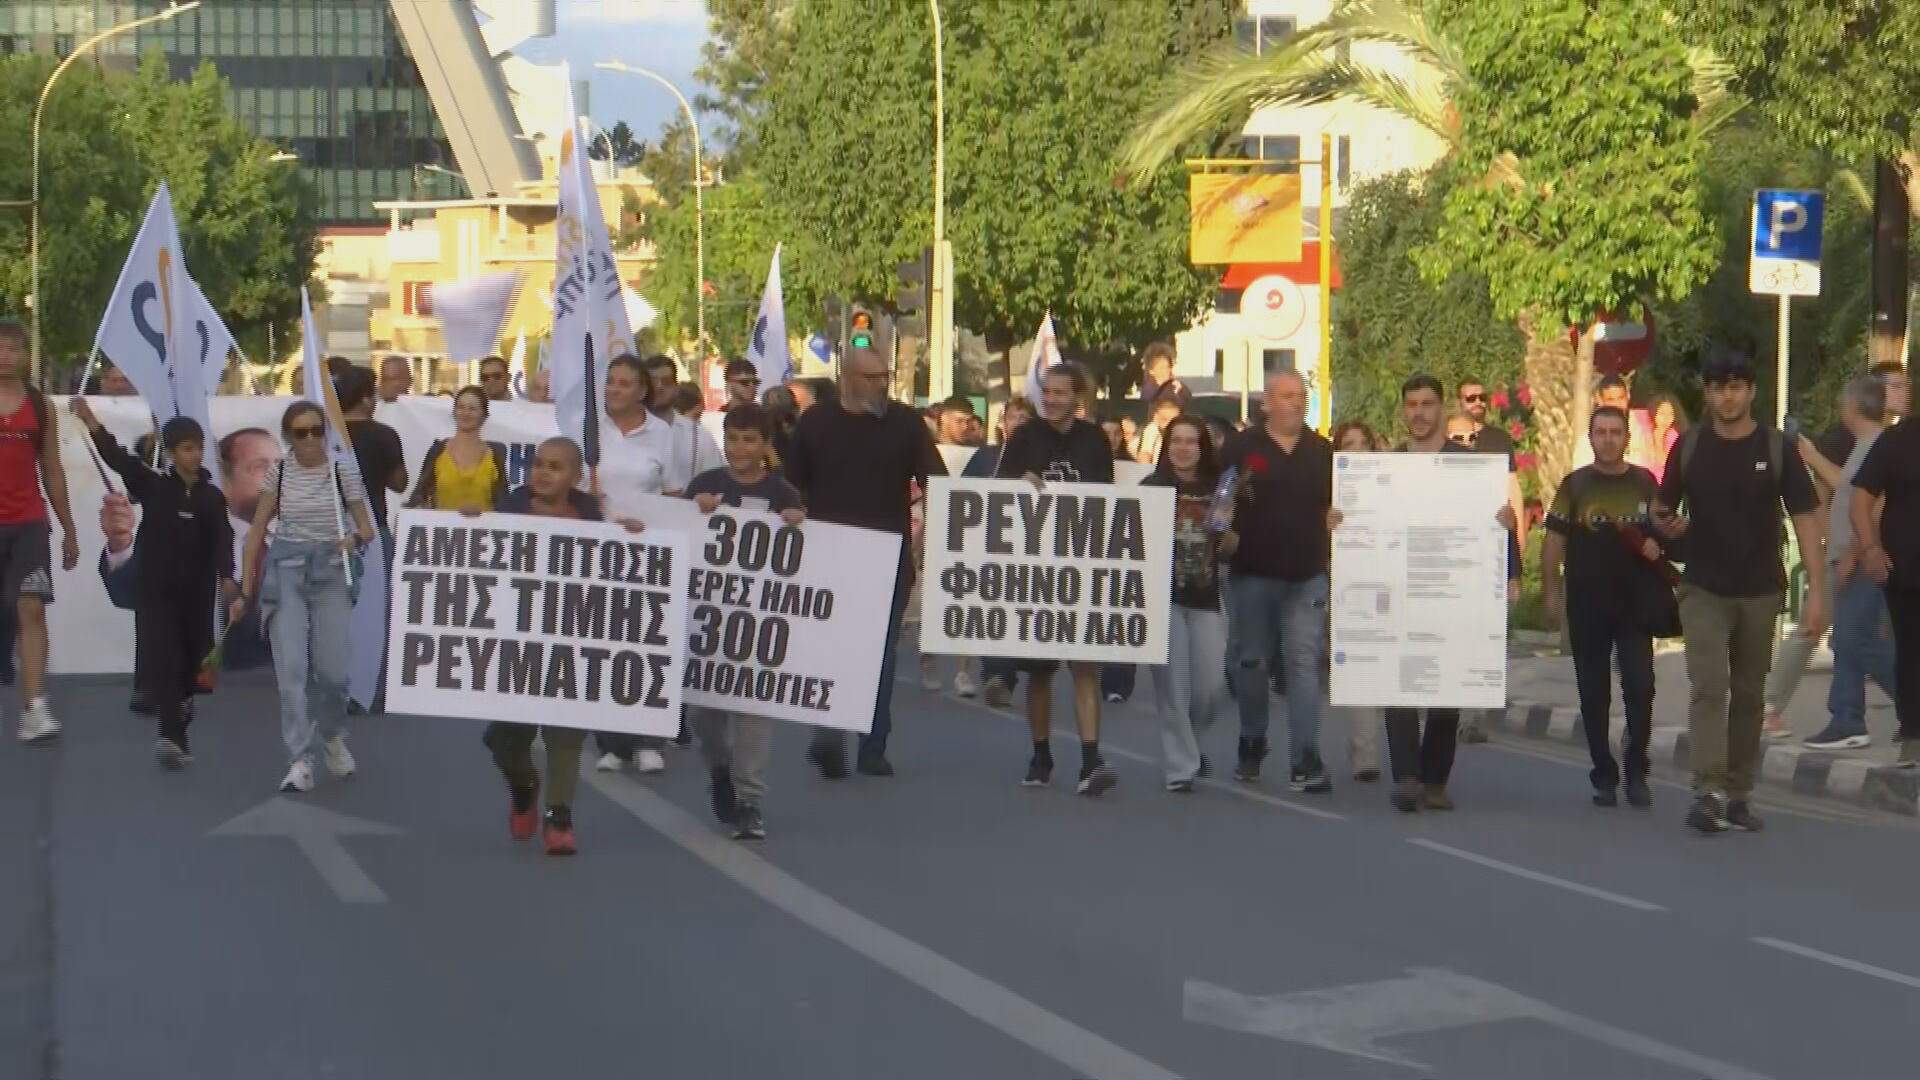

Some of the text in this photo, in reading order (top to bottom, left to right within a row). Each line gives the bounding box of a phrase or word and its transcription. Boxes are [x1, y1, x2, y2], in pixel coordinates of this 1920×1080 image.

[1769, 201, 1808, 249] P
[403, 525, 673, 587] ΑΜΕΣΗ ΠΤΩΣΗ
[704, 514, 804, 577] 300
[947, 490, 1146, 560] ΡΕΥΜΑ
[401, 571, 672, 646] ΤΗΣ ΤΙΜΗΣ
[688, 568, 834, 621] ΕΡΕΣ ΗΛΙΟ
[940, 561, 1082, 606] ΦΘΗΝΟ
[1090, 568, 1146, 608] ΓΙΑ
[689, 604, 790, 667] 300
[943, 604, 1147, 647] ΟΛΟ ΤΟΝ ΛΑΟ
[401, 632, 672, 709] ΡΕΥΜΑΤΟΣ
[682, 658, 834, 711] ΑΙΟΛΟΓΙΕΣ
